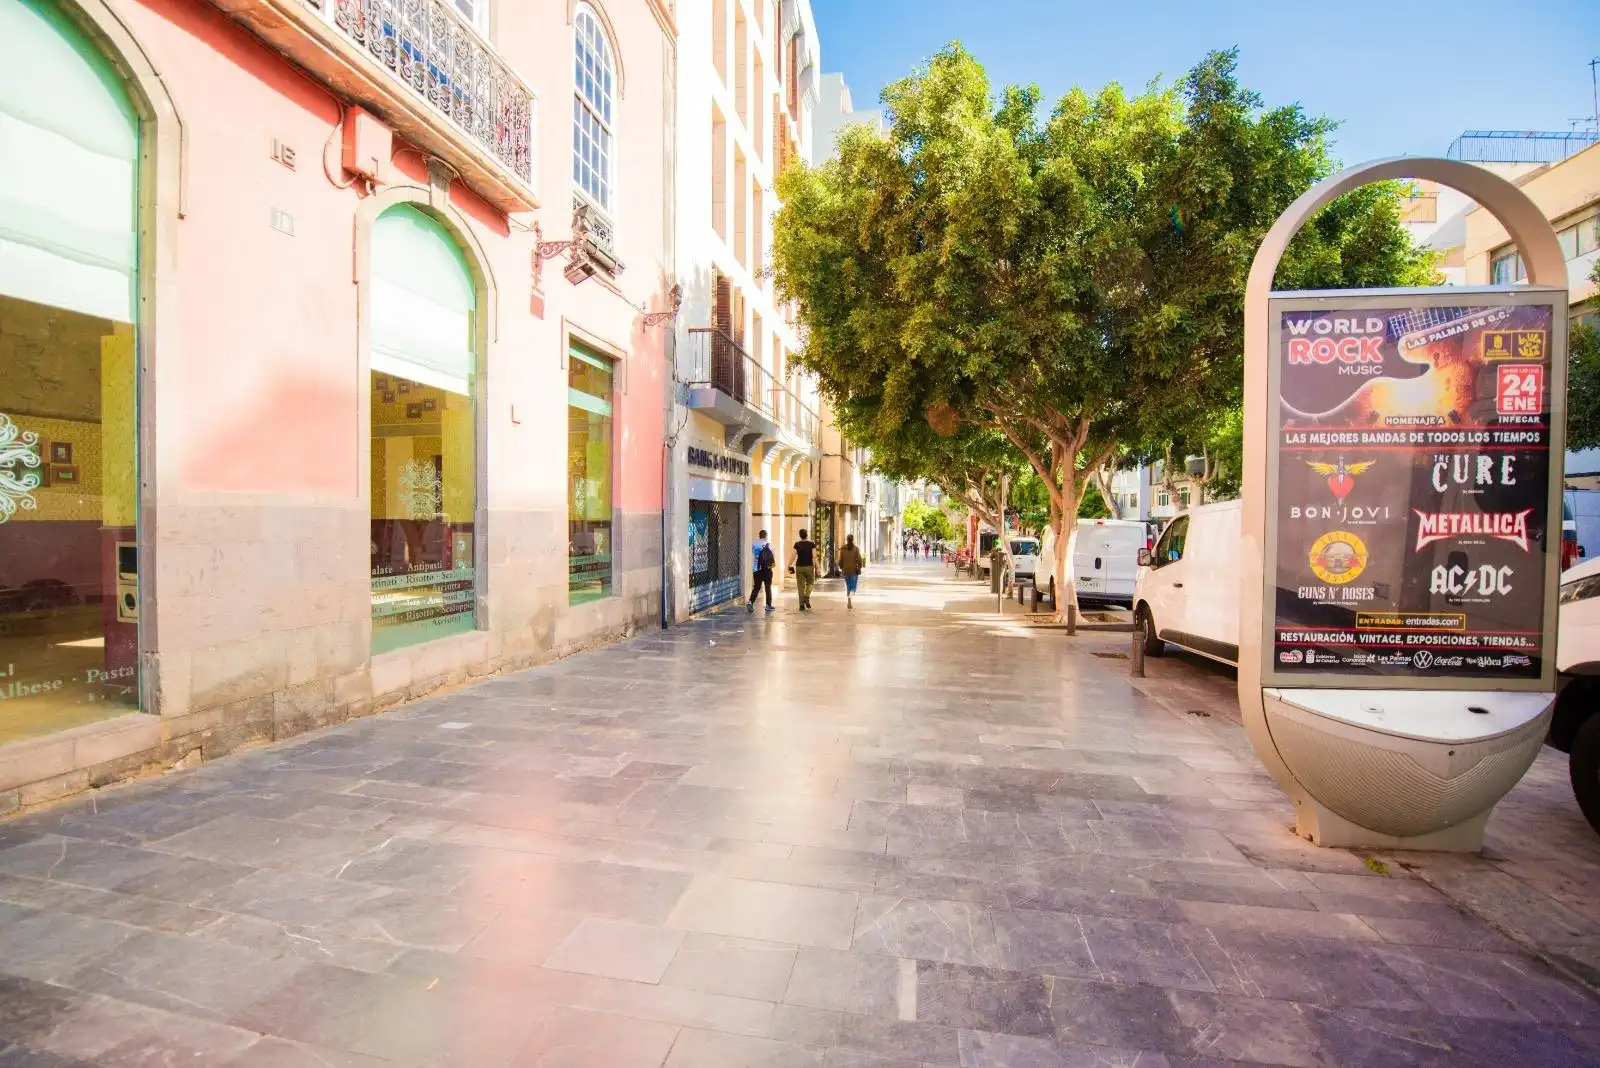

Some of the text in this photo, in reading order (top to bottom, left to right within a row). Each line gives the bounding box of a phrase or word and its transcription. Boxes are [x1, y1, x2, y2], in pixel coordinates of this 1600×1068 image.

[1286, 318, 1383, 335] WORLD
[1407, 336, 1427, 349] LAS
[1429, 323, 1469, 342] PALMAS
[1471, 317, 1486, 328] DE
[1288, 336, 1384, 365] ROCK
[1338, 365, 1383, 375] MUSIC
[1503, 374, 1537, 396] 24
[1502, 397, 1536, 411] ENE
[1386, 416, 1445, 425] HOMENAJE A
[1499, 415, 1540, 424] INFECAR
[1286, 432, 1541, 445] LAS MEJORES BANDAS DE TODOS LOS TIEMPOS
[1434, 454, 1450, 463] THE
[1432, 454, 1516, 492] CURE
[1412, 508, 1535, 554] METALLICA
[408, 560, 443, 572] Antipasti
[407, 575, 434, 584] Risotto
[1298, 586, 1326, 600] GUNS
[1342, 587, 1375, 600] ROSES
[407, 610, 435, 621] Risotto
[1406, 617, 1459, 626] entradas.com
[1281, 632, 1535, 647] RESTAURACIÓN, VINTAGE, EXPOSICIONES, TIENDAS...
[85, 666, 135, 683] Pasta
